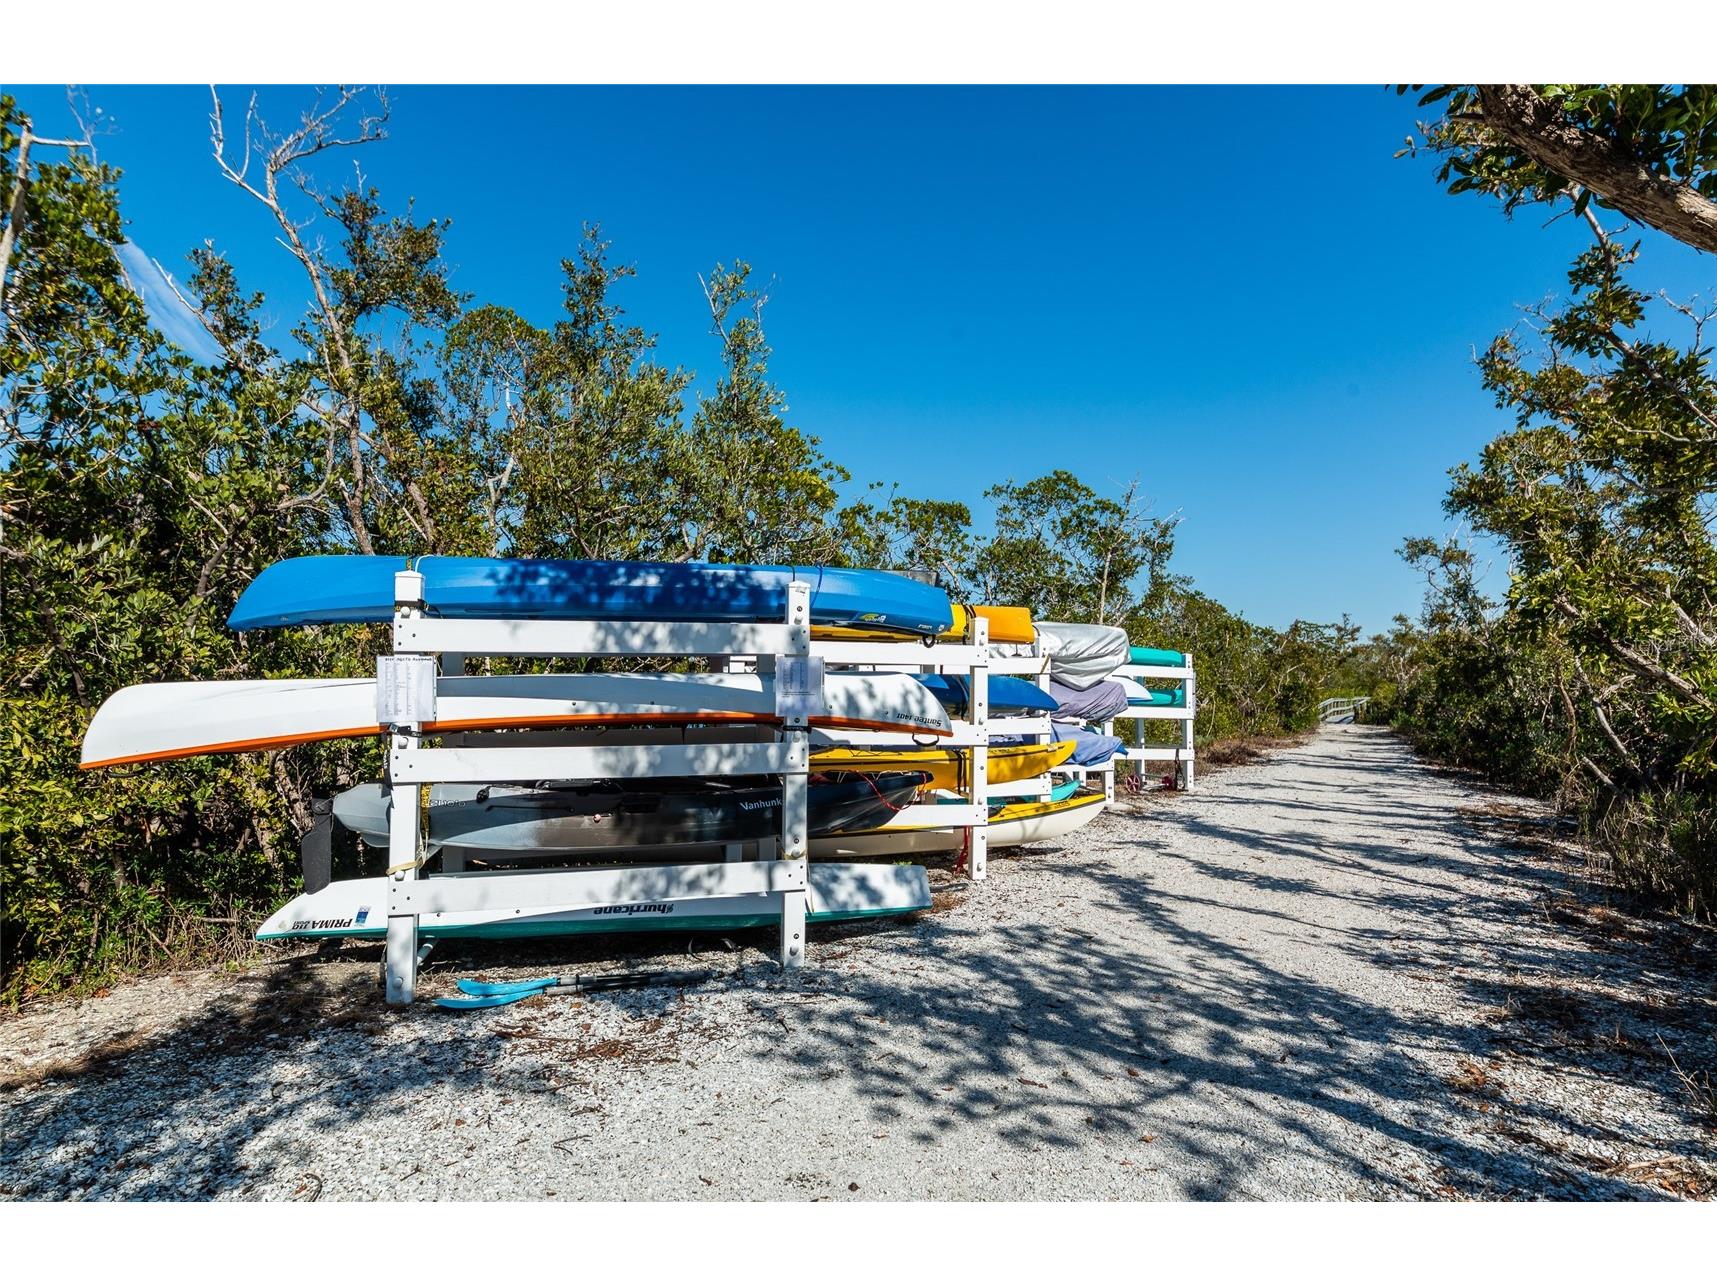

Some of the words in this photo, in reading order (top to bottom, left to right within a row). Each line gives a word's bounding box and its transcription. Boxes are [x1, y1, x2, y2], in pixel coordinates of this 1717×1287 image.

[914, 716, 942, 727] Santee
[593, 904, 668, 915] hurricane
[311, 919, 353, 929] PRIMA
